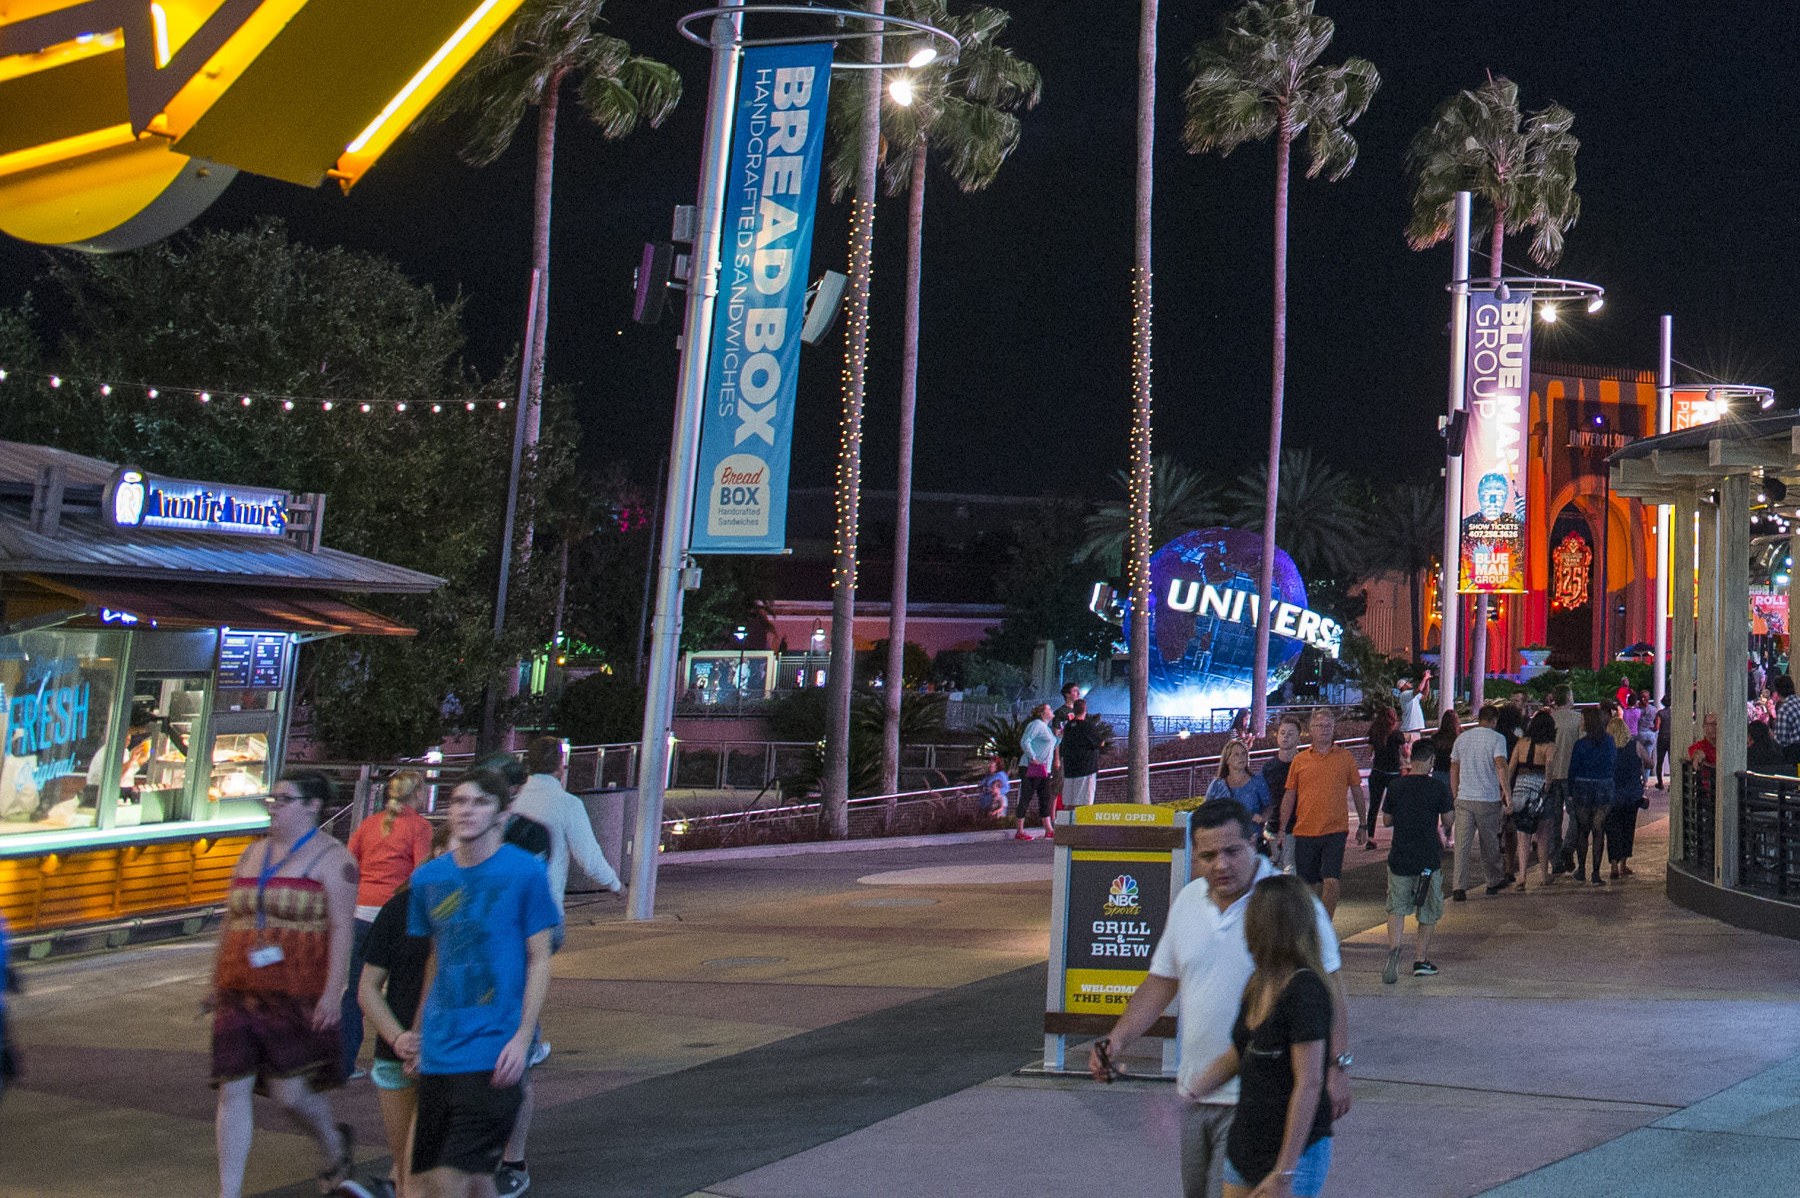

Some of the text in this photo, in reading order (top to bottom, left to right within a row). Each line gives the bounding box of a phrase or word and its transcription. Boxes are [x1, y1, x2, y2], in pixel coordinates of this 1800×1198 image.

[718, 68, 772, 417] HANDCRAFTED SANDWICHES
[733, 66, 816, 447] BREAD BOX
[1472, 304, 1500, 419] GROUP
[1495, 302, 1526, 474] BLUE MAN
[720, 466, 764, 485] Bread
[720, 487, 760, 505] BOX
[151, 488, 289, 528] Auntie Anne's
[718, 507, 760, 516] Handcrafted
[718, 517, 759, 526] Sandwiches
[1475, 552, 1509, 564] BLUE
[1475, 563, 1509, 576] MAN
[1474, 575, 1509, 584] GROUP
[1755, 595, 1787, 606] ROLL
[4, 682, 90, 757] FRESH
[1095, 812, 1156, 822] NOW OPEN
[1108, 894, 1139, 907] NBC
[1102, 901, 1142, 917] Sports
[1092, 920, 1151, 935] GRILL
[1116, 934, 1126, 944] &
[1091, 942, 1151, 957] BREW
[1073, 994, 1102, 1003] THE
